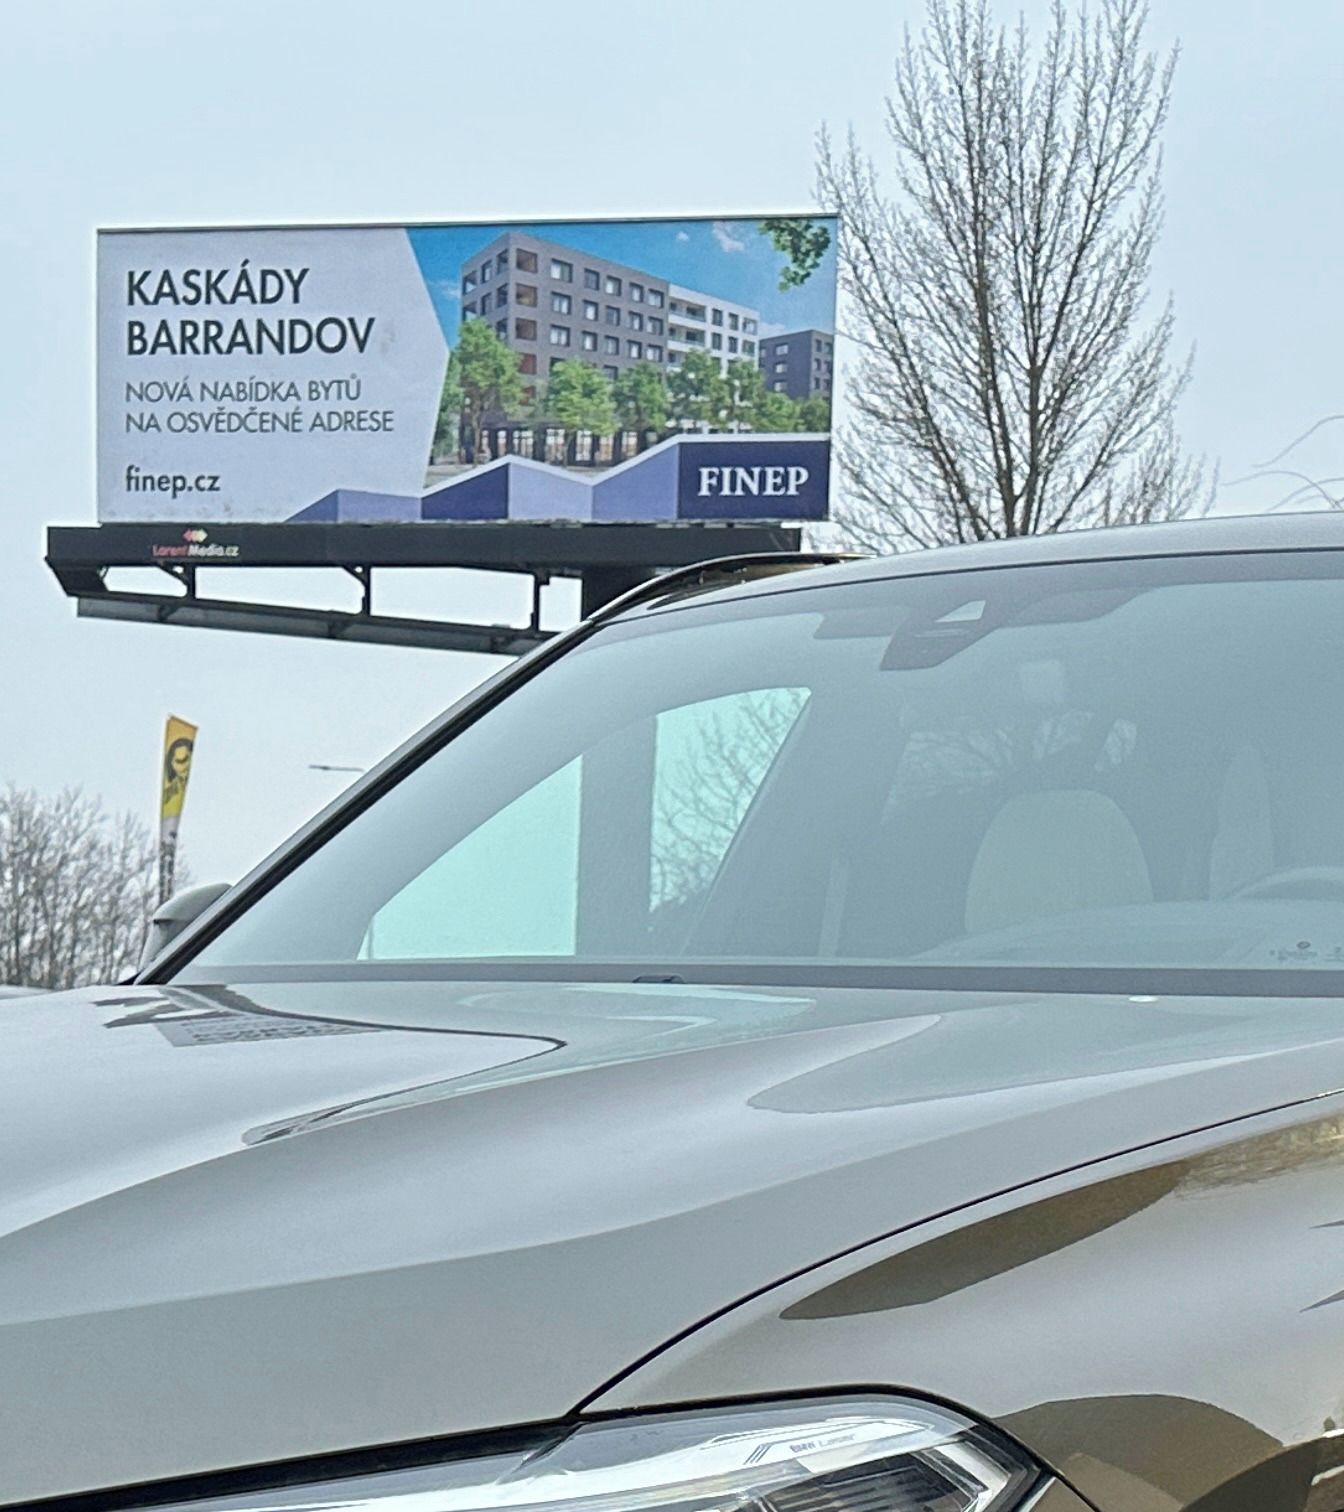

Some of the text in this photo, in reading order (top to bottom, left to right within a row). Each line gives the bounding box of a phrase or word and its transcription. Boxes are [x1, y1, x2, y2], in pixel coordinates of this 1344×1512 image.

[127, 258, 311, 306] KASKÁDY
[127, 317, 376, 356] BARRANDOV
[125, 373, 362, 402] NOVÁ NABÍDKA BYTŮ
[125, 406, 395, 433] NA OSVĚDČENÉ ADRESE
[125, 464, 222, 499] finep.cz
[697, 466, 809, 497] FINEP
